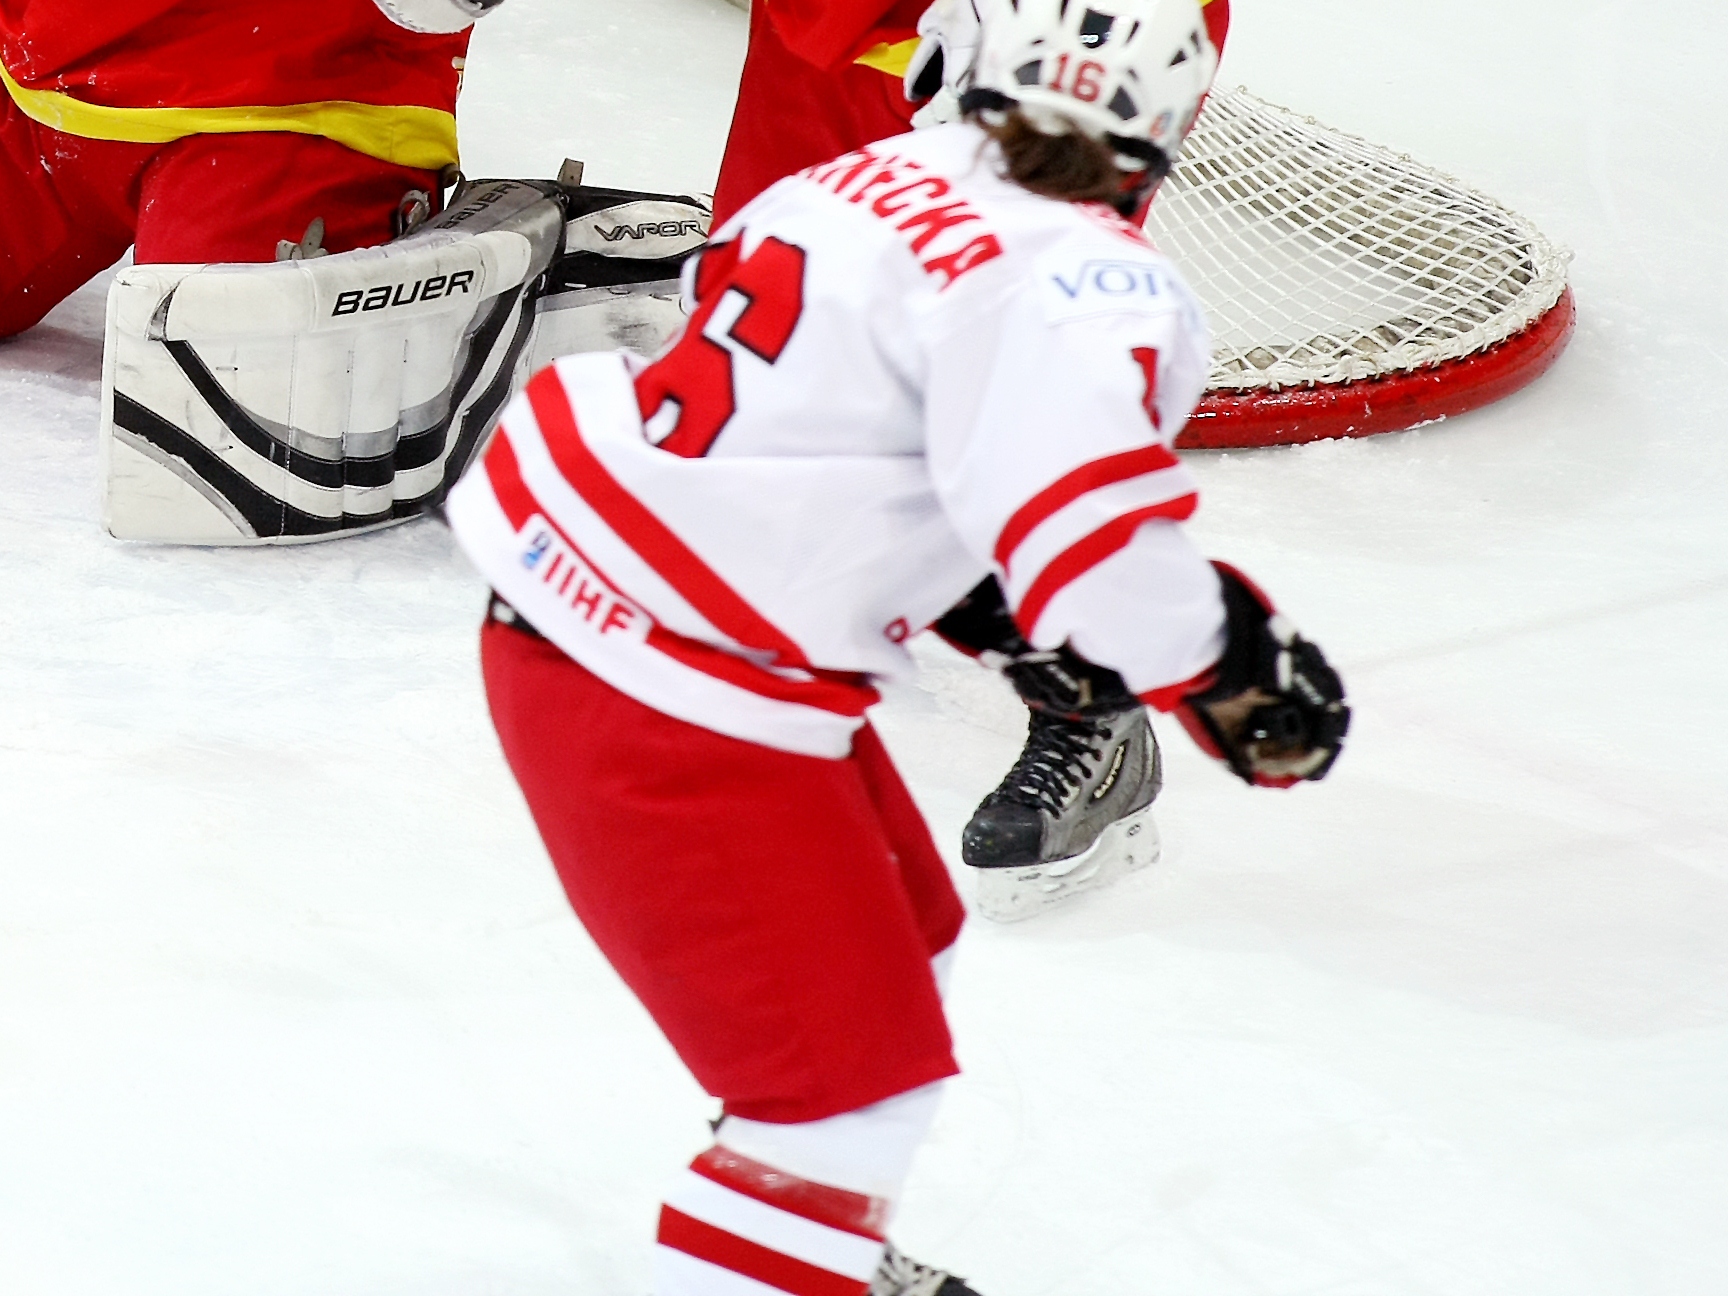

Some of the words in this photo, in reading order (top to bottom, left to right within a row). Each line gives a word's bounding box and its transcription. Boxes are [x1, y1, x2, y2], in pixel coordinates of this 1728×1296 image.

[1048, 52, 1107, 103] 16
[433, 183, 521, 230] BAUER
[593, 220, 710, 242] VAPOR
[332, 269, 475, 317] BAUER
[542, 551, 637, 637] IIHF
